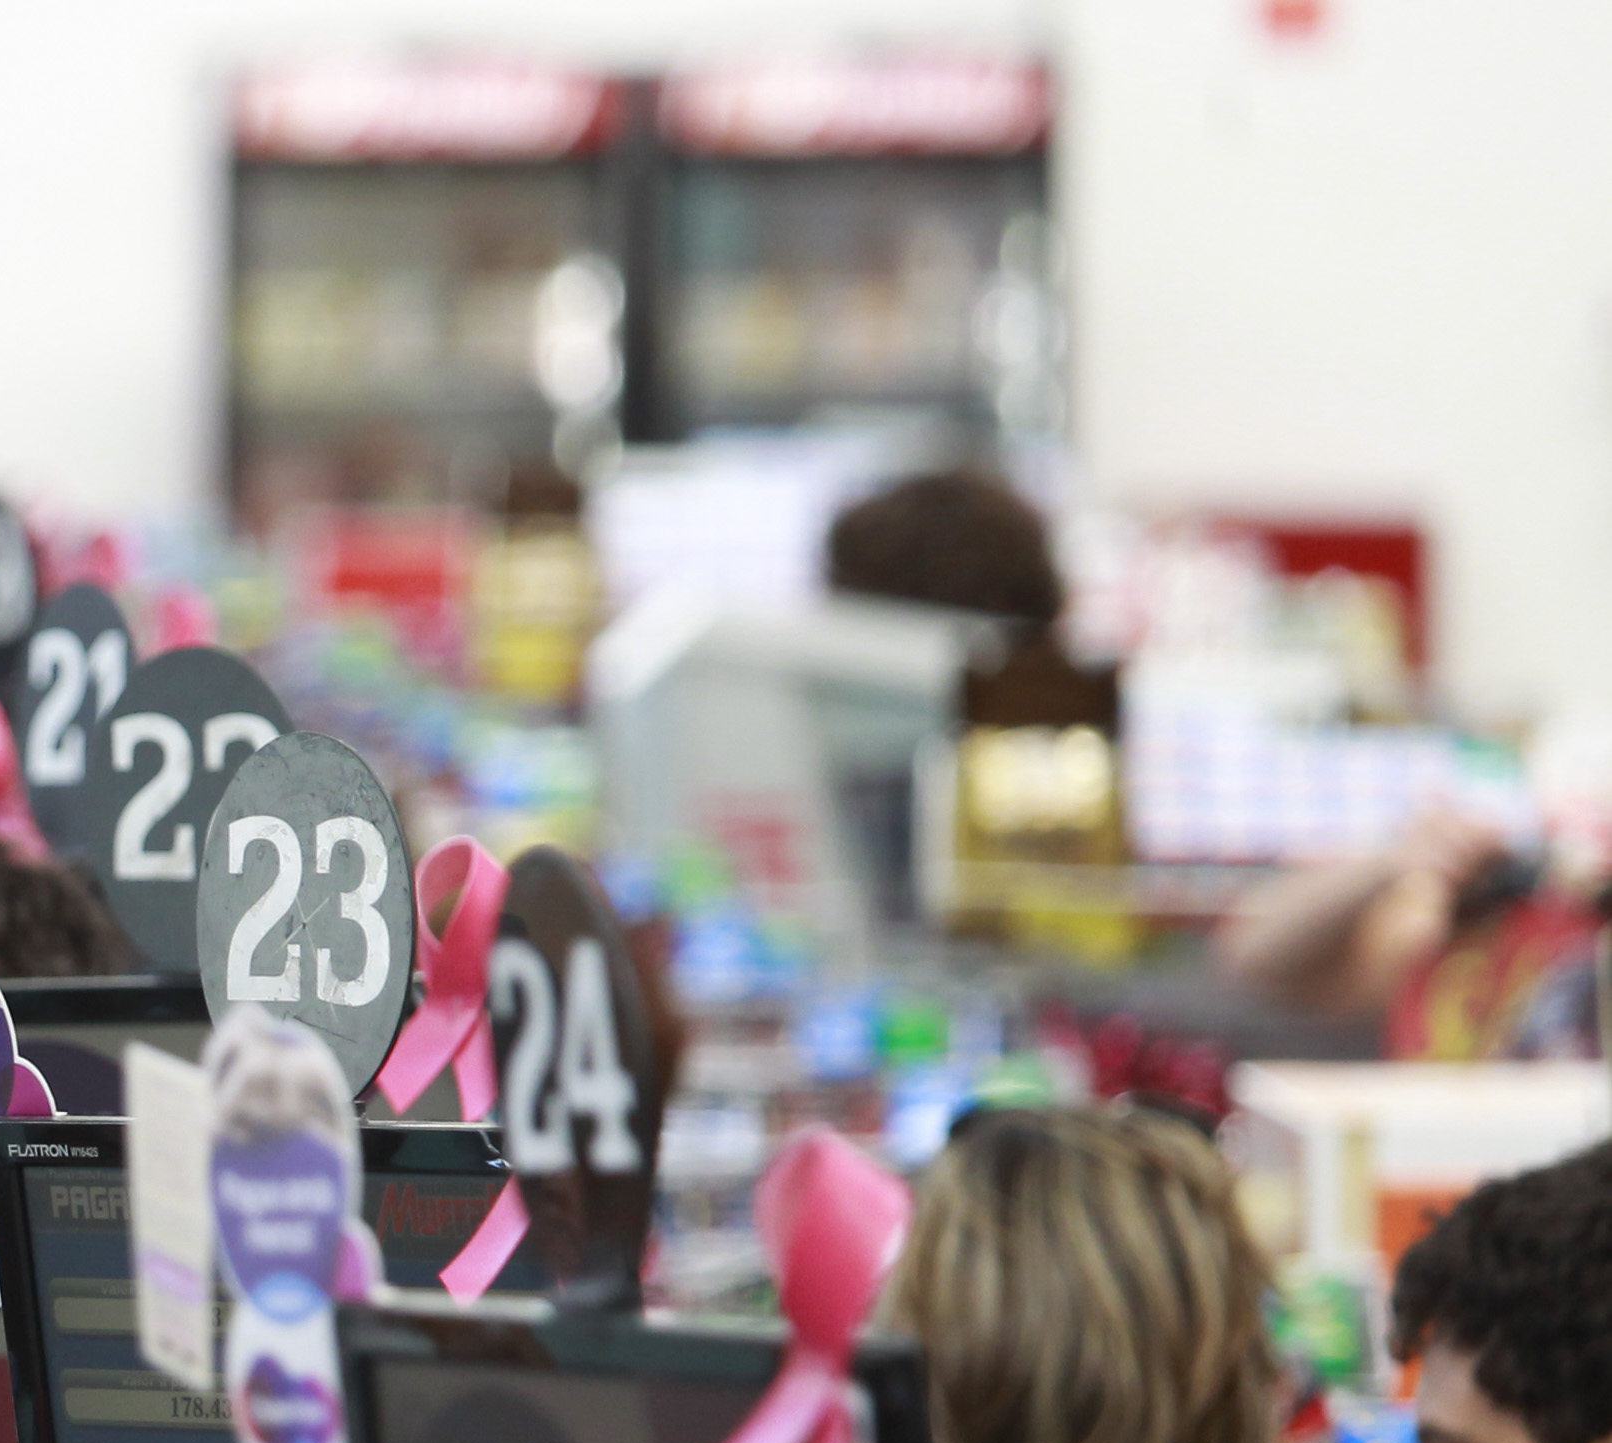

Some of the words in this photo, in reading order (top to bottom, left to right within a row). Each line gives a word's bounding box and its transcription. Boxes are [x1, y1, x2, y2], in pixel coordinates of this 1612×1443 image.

[26, 627, 128, 786] 21
[227, 814, 391, 1008] 23
[487, 936, 643, 1177] 24
[7, 1144, 69, 1158] FLATRON
[49, 1185, 130, 1220] PAGA
[170, 1397, 232, 1419] 178.43
